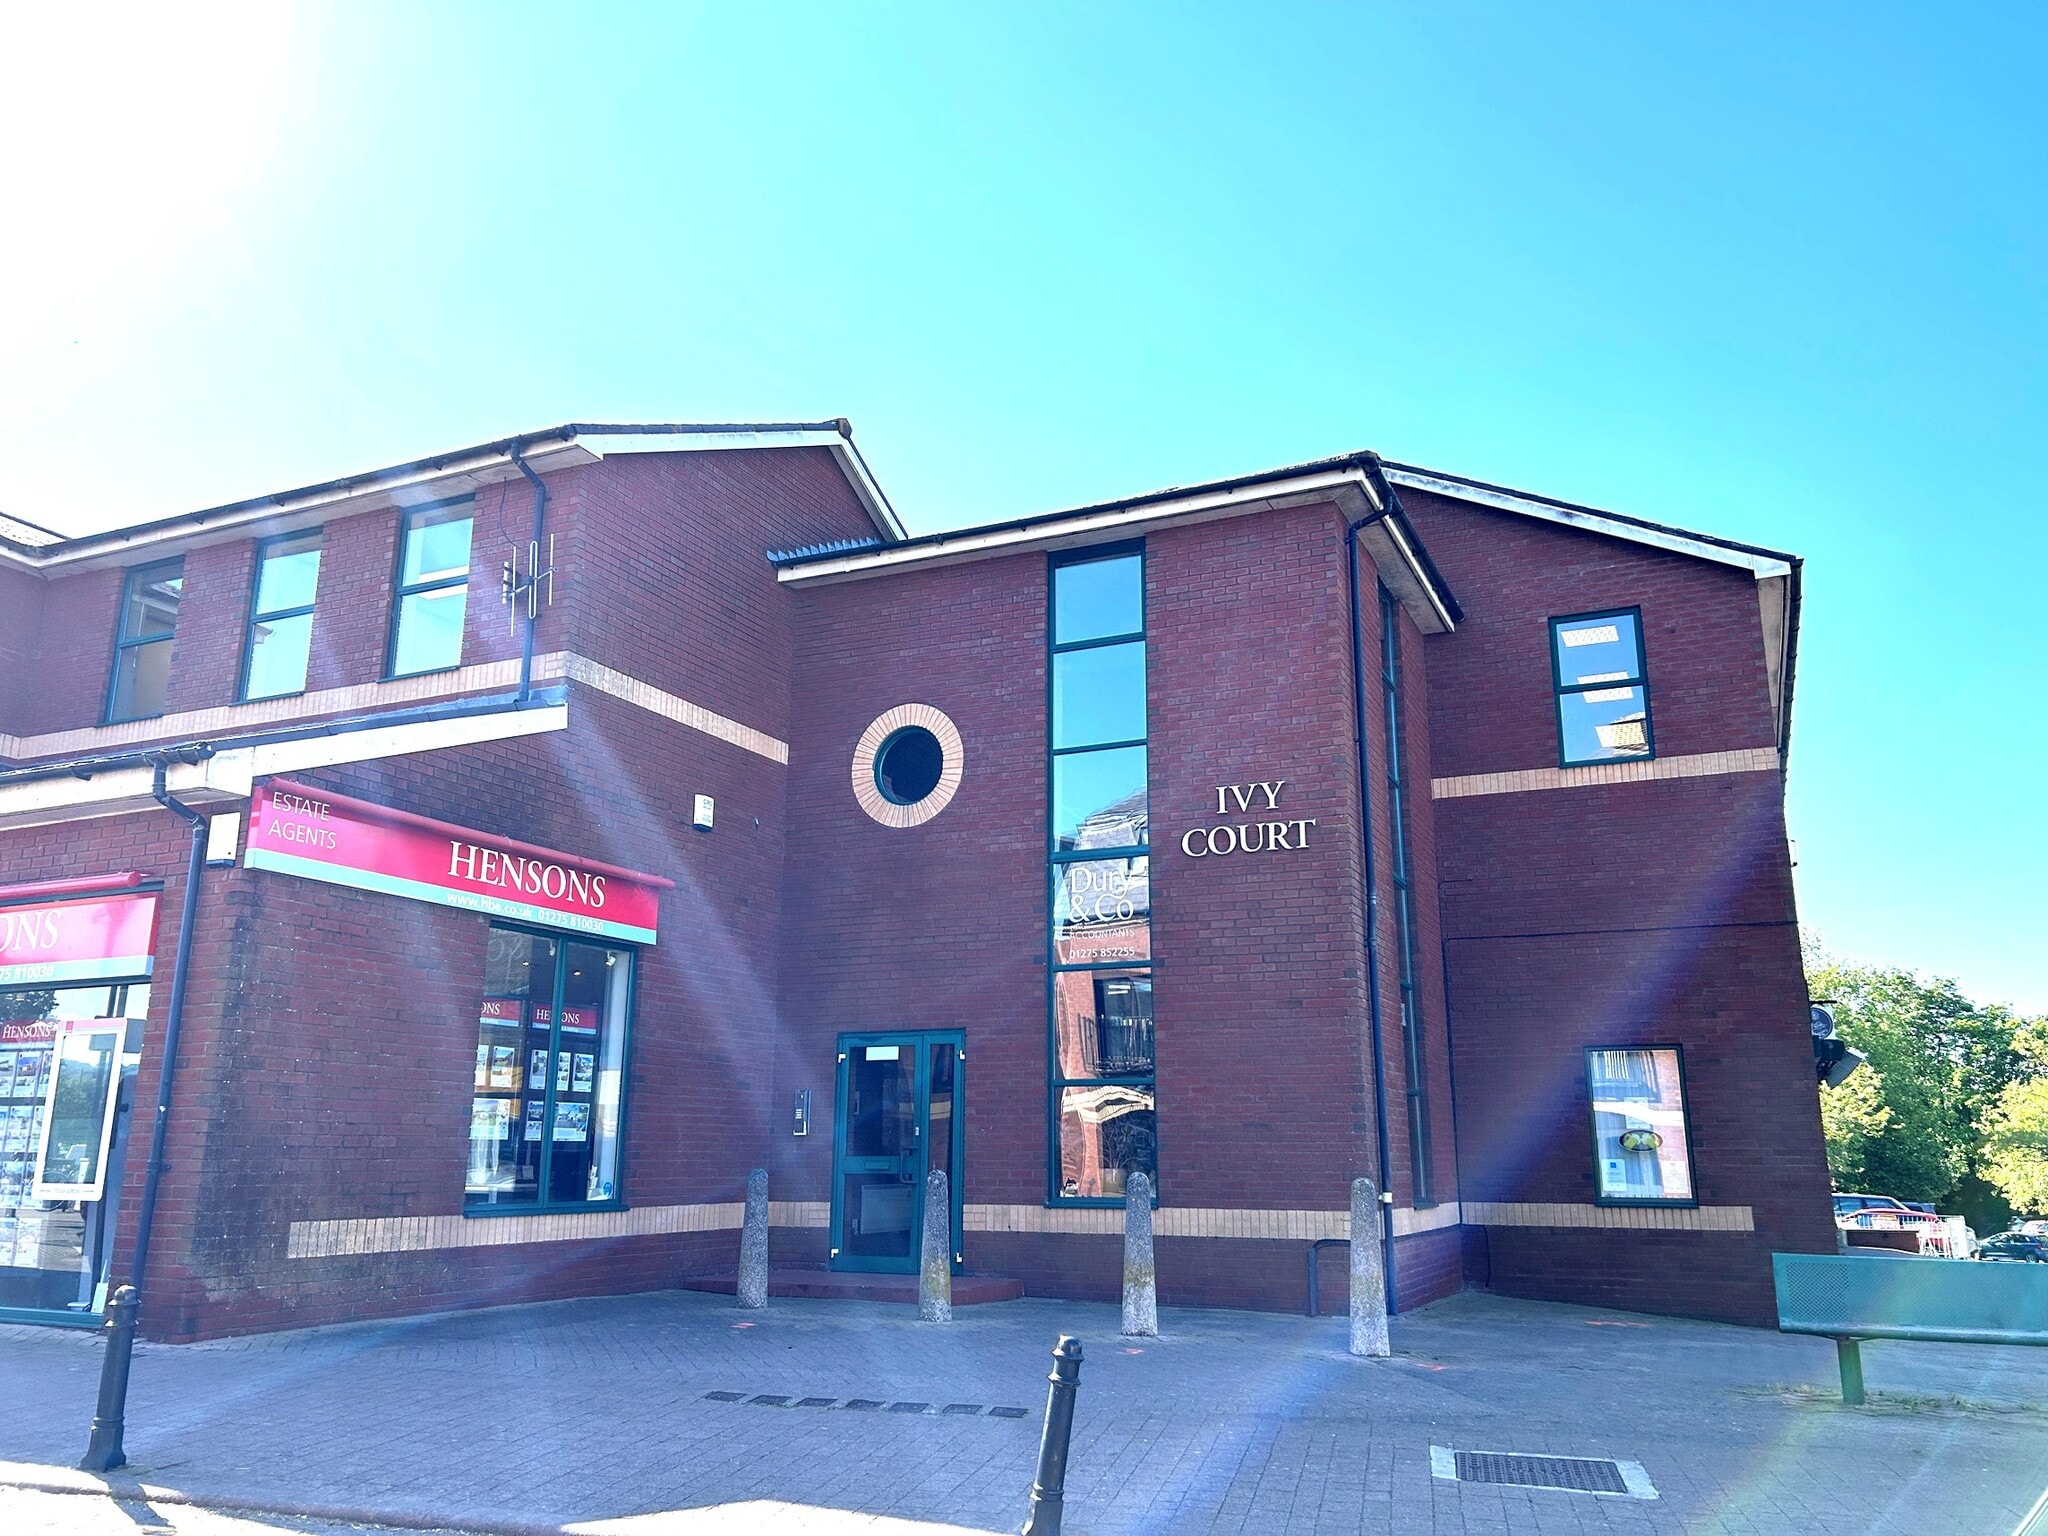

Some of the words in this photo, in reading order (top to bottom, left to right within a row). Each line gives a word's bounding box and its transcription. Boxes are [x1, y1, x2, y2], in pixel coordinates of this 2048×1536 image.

[272, 791, 331, 821] ESTATE
[1216, 781, 1285, 814] IVY
[267, 819, 336, 849] AGENTS
[1181, 819, 1316, 857] COURT
[448, 841, 606, 908] HENSONS
[1071, 866, 1132, 899] Dury
[447, 892, 533, 919] www.hbe.co.uk
[537, 909, 568, 925] 01275
[570, 914, 604, 932] 810030
[1069, 928, 1135, 940] ACCOUNTANTS
[1069, 948, 1098, 959] 01275
[1100, 946, 1135, 958] 852255
[13, 964, 55, 980] 810030
[2, 1024, 51, 1039] HENSONS
